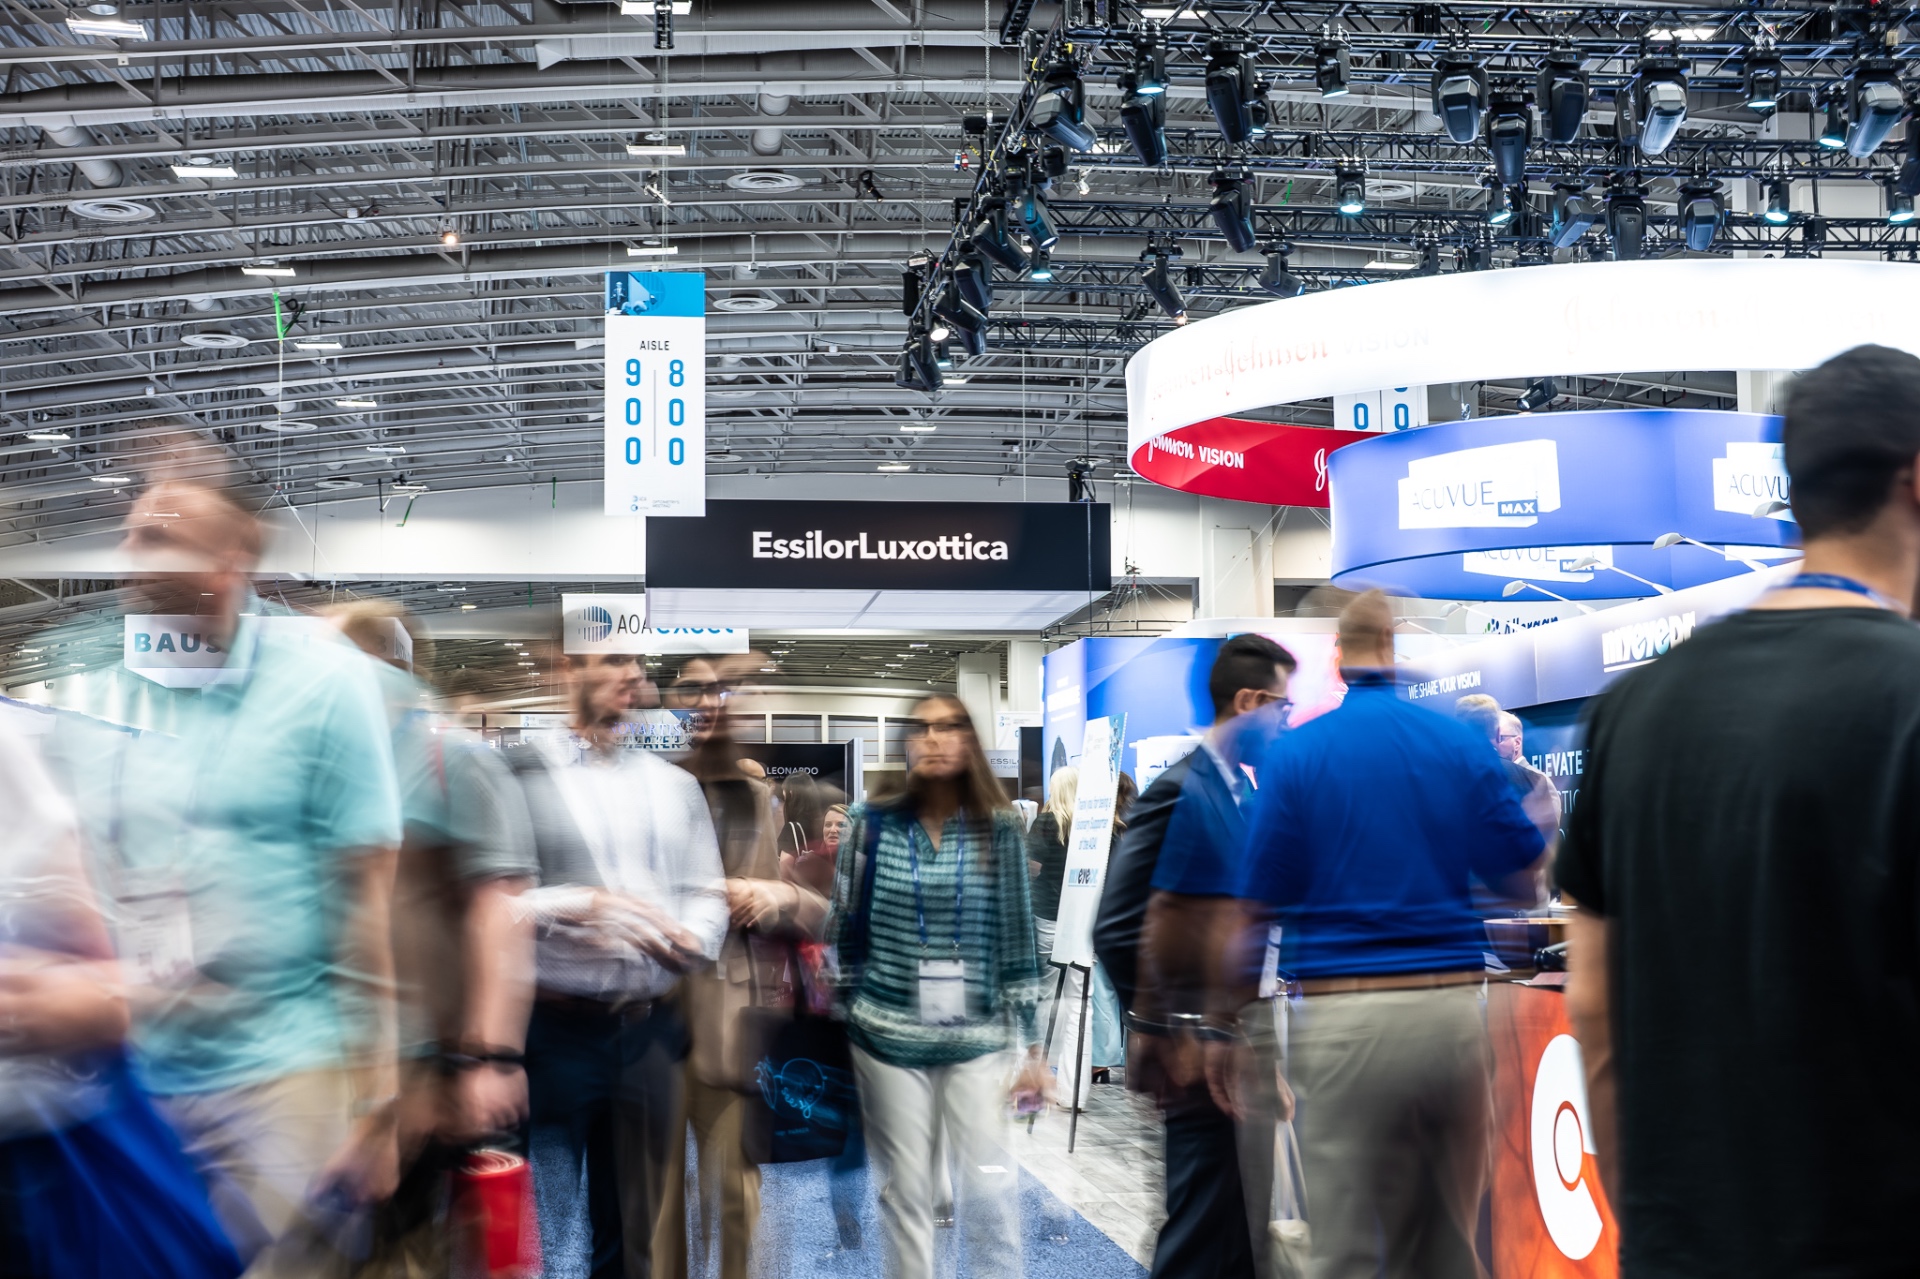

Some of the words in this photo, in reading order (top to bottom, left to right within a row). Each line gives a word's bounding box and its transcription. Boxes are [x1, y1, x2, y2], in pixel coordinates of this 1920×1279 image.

[640, 340, 670, 351] AISLE
[1199, 445, 1244, 469] VISION
[1412, 480, 1495, 510] ACUVUE
[1501, 501, 1535, 515] MAX
[1729, 474, 1790, 501] ACUVU
[752, 530, 1009, 560] EssilorLuxottica
[134, 632, 223, 653] BAUS
[1408, 684, 1419, 700] WE
[1419, 680, 1438, 698] SHARE
[1438, 675, 1457, 694] YOUR
[1456, 670, 1481, 690] VISION
[1532, 750, 1583, 777] ELEVATE
